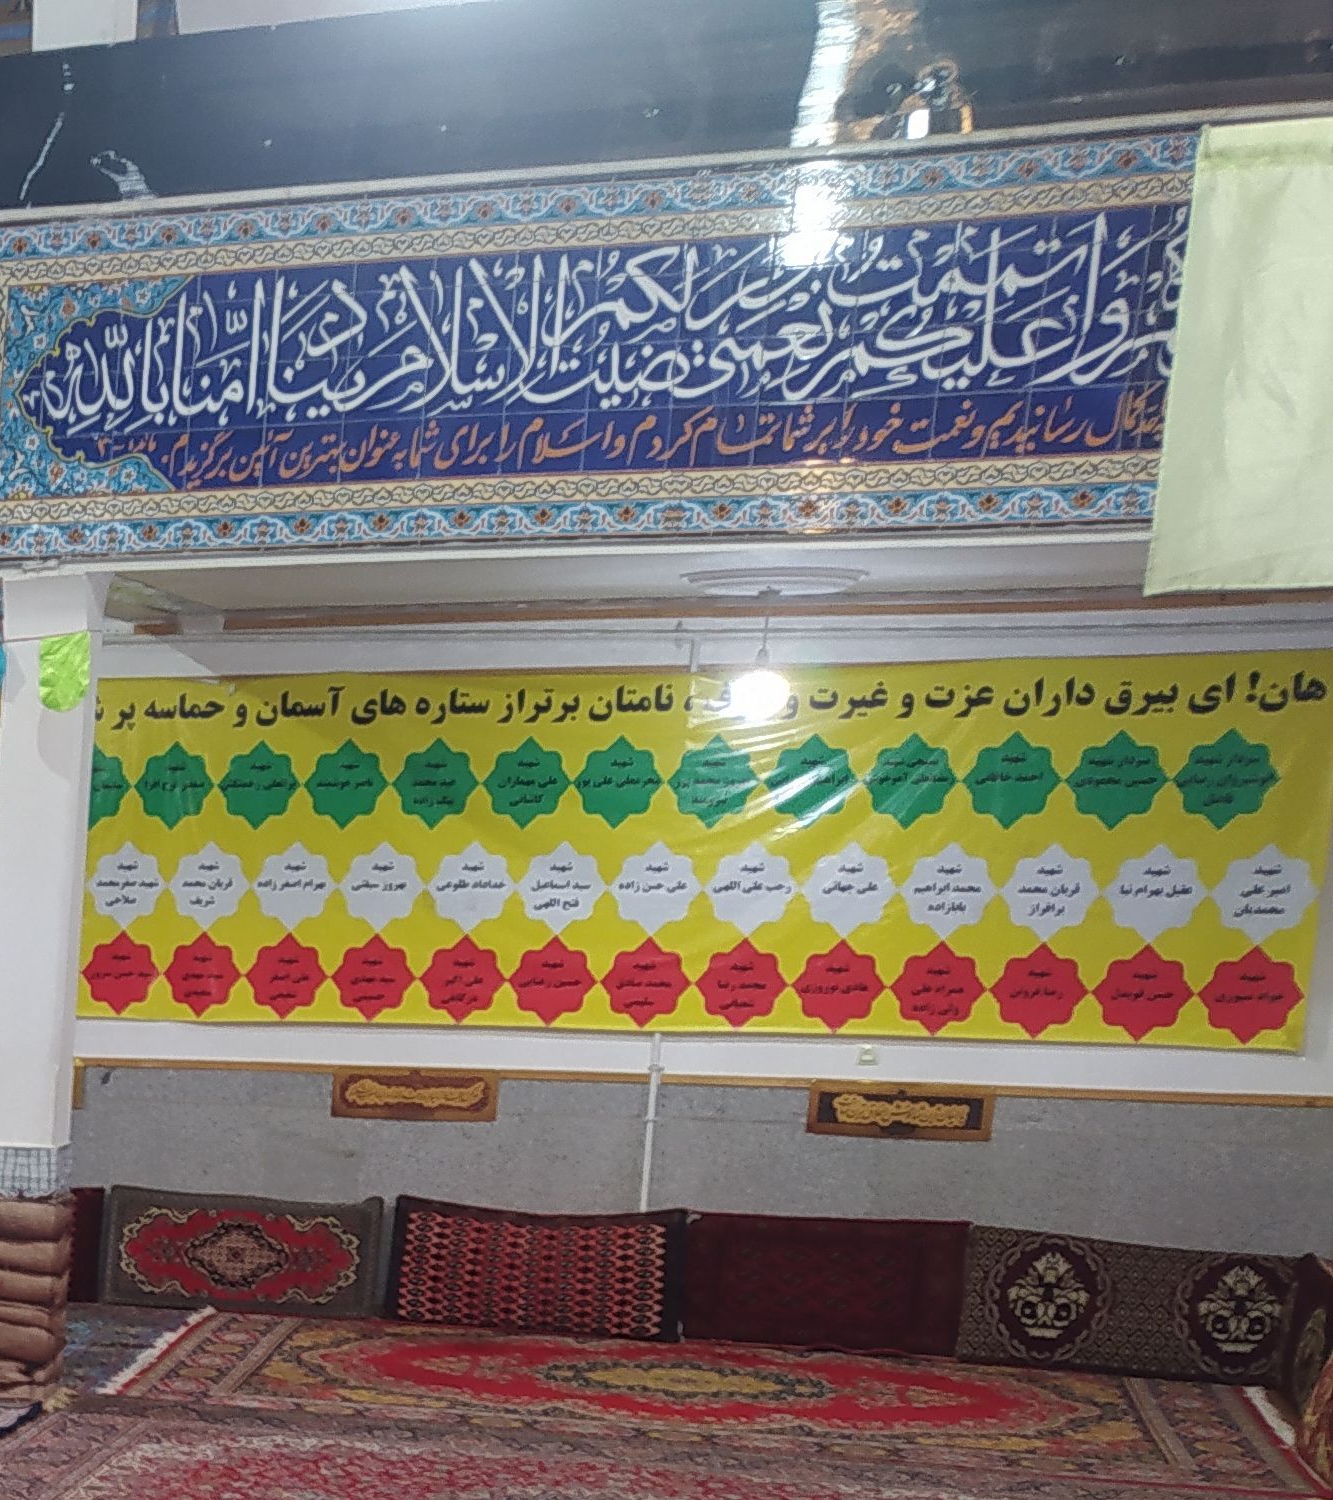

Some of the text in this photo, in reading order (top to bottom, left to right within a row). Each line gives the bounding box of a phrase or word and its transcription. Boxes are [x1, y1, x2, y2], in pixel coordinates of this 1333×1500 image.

[433, 422, 495, 471] برای
[808, 680, 889, 720] غیرت
[1002, 676, 1096, 718] داران
[1103, 679, 1179, 717] بیرق
[1187, 673, 1237, 715] ای
[143, 692, 226, 720] حماسه
[255, 685, 345, 727] آسمان
[351, 688, 407, 726] های
[415, 686, 490, 725] ستاره
[588, 683, 675, 721] نامتان
[895, 691, 916, 719] و
[926, 684, 995, 719] عزت
[110, 702, 136, 731] پر
[232, 703, 248, 728] و
[116, 859, 140, 871] شهید
[197, 860, 221, 872] شهید
[283, 860, 308, 872] شهید
[371, 860, 396, 872] شهید
[460, 860, 485, 873] شهید
[549, 860, 574, 873] شهید
[644, 860, 670, 873] شهید
[739, 861, 766, 875] شهید
[837, 861, 865, 875] شهید
[936, 863, 964, 876] شهید
[1036, 864, 1064, 877] شهید
[1142, 864, 1172, 878] شهید
[1252, 864, 1283, 878] شهید
[618, 879, 641, 894] زاده
[665, 880, 688, 894] علی
[855, 881, 879, 895] علی
[951, 884, 982, 893] محمد
[1016, 882, 1081, 898] قربان محمد
